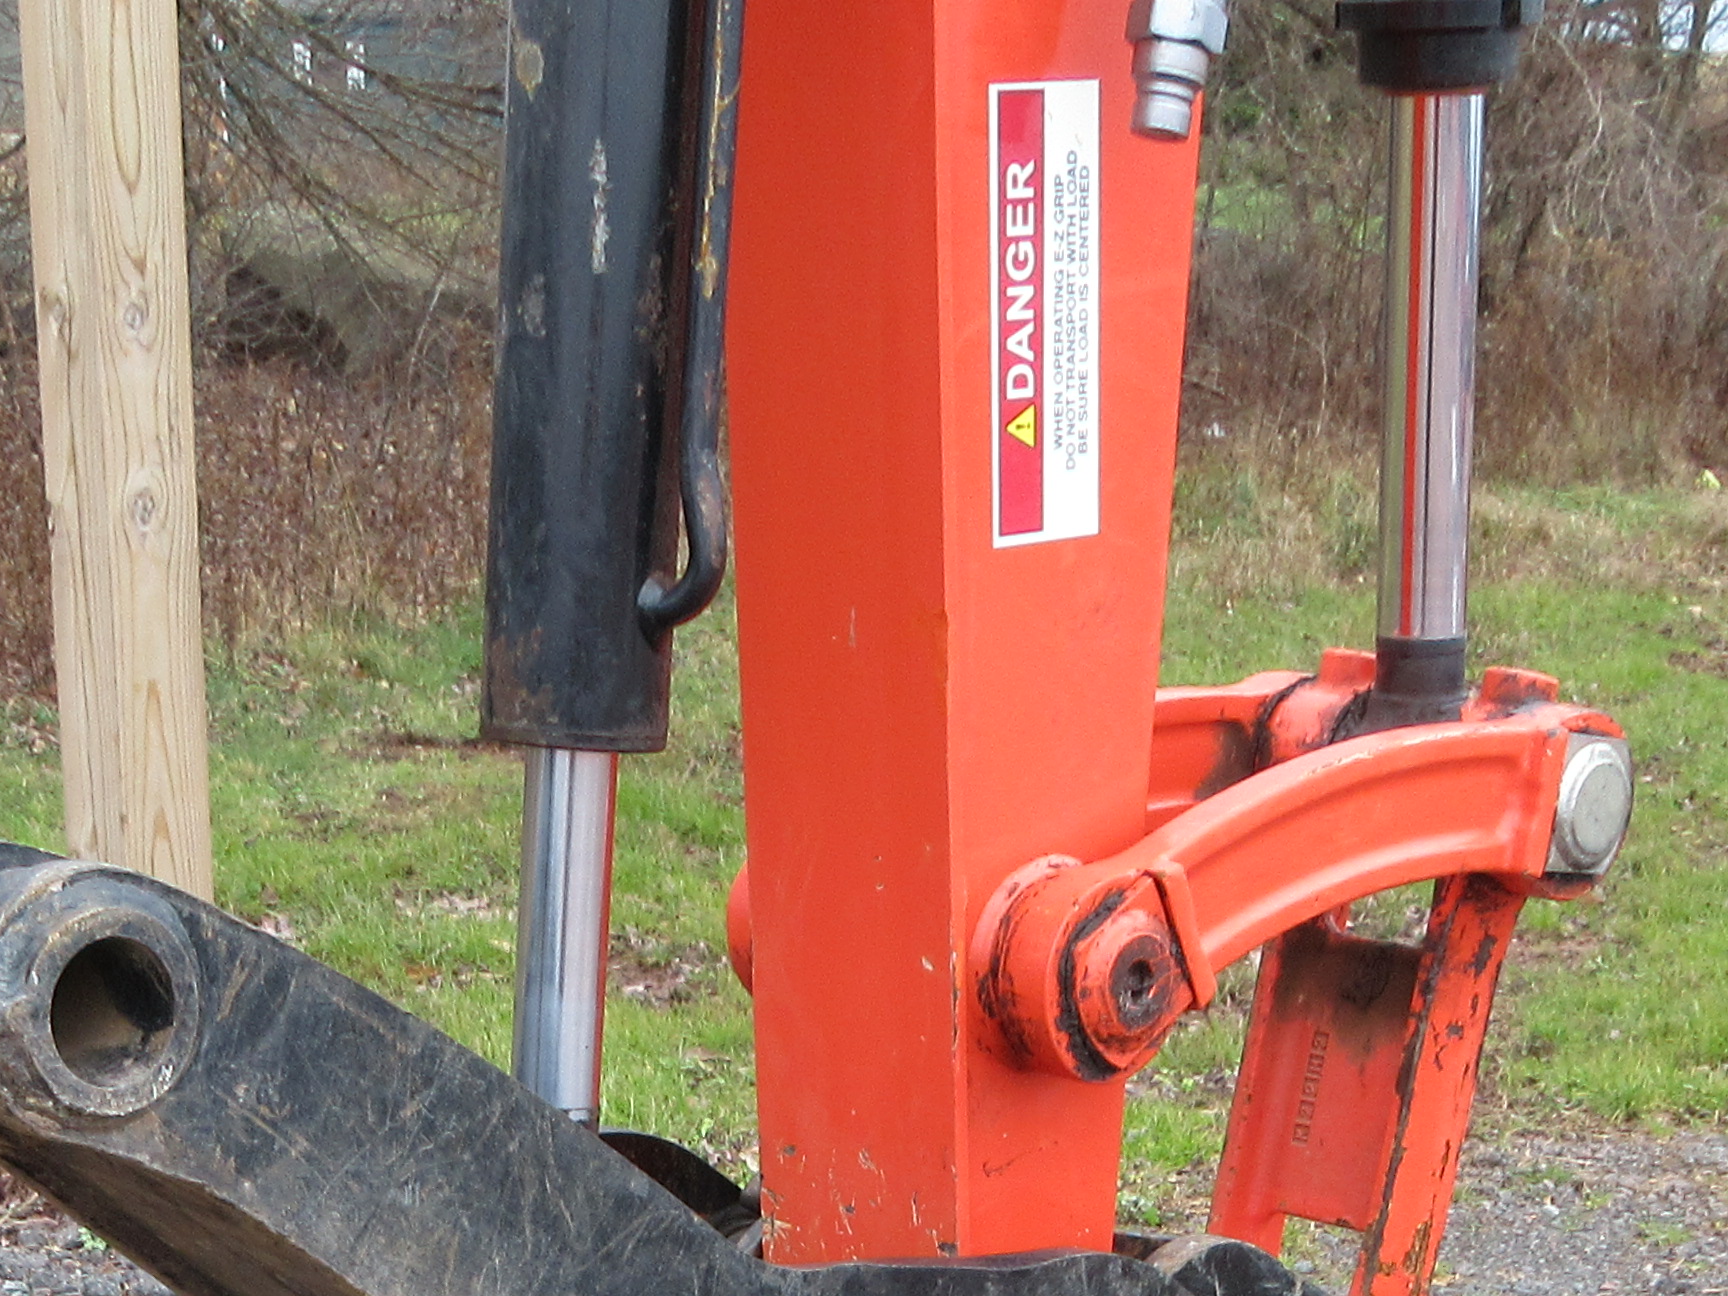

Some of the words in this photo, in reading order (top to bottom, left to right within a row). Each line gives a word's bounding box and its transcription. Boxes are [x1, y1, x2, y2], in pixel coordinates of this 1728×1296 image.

[1054, 174, 1065, 224] GRIP
[1067, 149, 1077, 206] LOAD
[1054, 229, 1065, 262] E-Z
[1067, 214, 1077, 264] WITH
[1079, 164, 1090, 277] CENTERED
[1005, 158, 1036, 400] DANGER
[1079, 283, 1089, 301] IS
[1054, 269, 1065, 385] OPERATING
[1066, 270, 1077, 392] TRANSPORT
[1079, 308, 1089, 362] LOAD
[1054, 391, 1064, 450] WHEN
[1066, 397, 1077, 435] NOT
[1078, 368, 1089, 421] SURE
[1066, 442, 1076, 470] DO
[1078, 428, 1089, 453] BE
